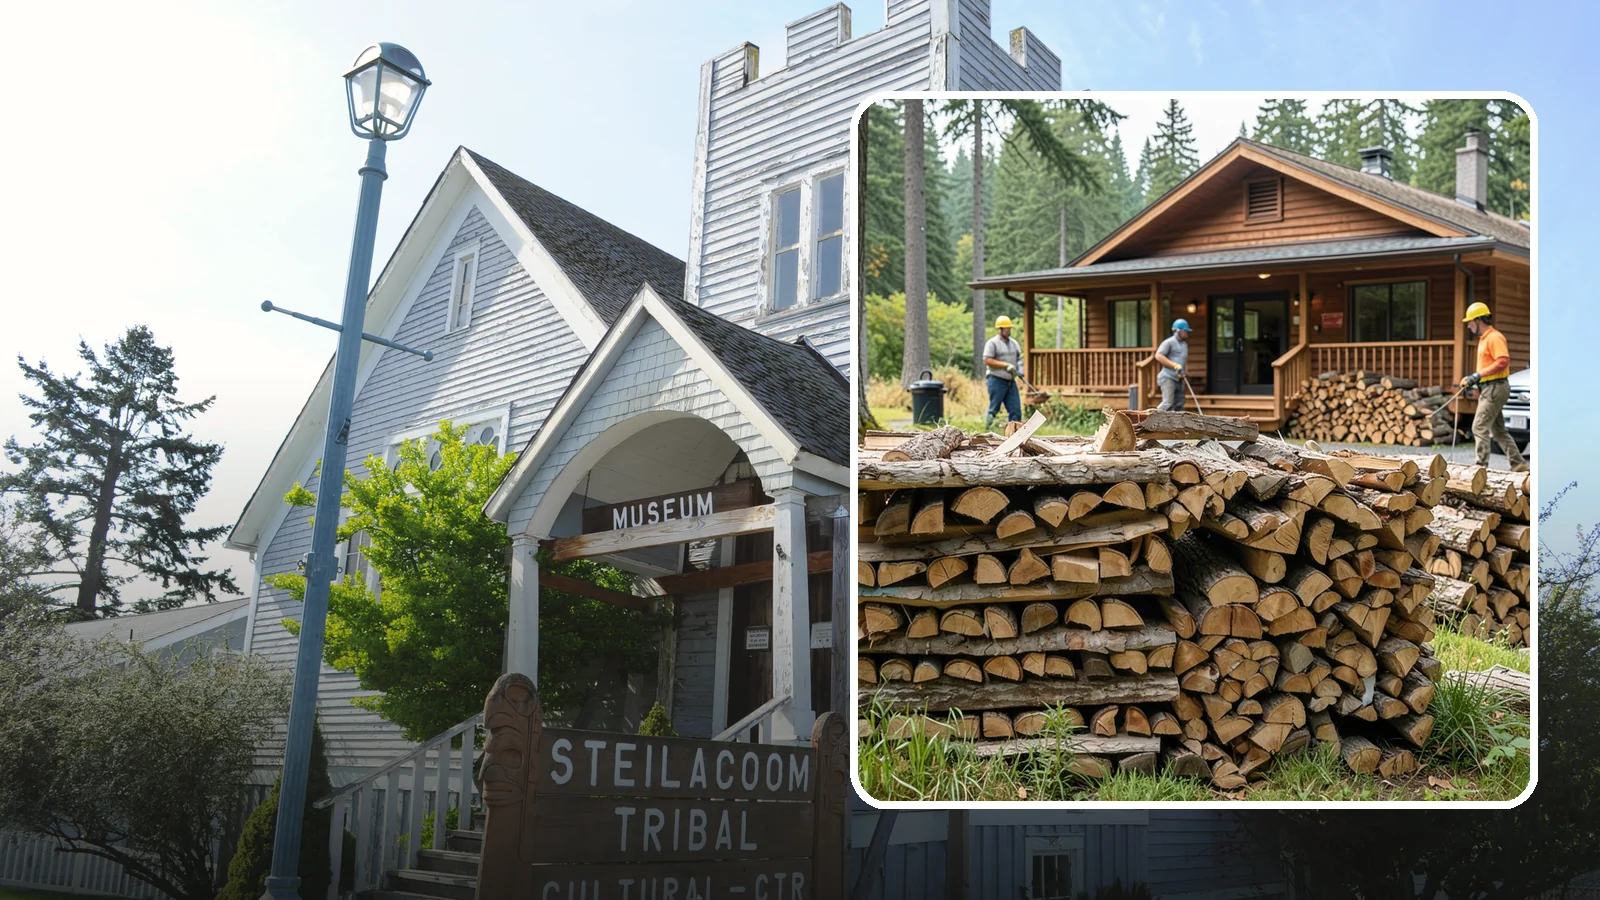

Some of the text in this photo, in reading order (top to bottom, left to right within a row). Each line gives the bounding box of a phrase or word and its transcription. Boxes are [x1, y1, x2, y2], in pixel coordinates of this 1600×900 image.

[612, 491, 714, 531] MUSEUM
[550, 738, 810, 793] STEILACOOM
[614, 806, 758, 852] TRIBAL
